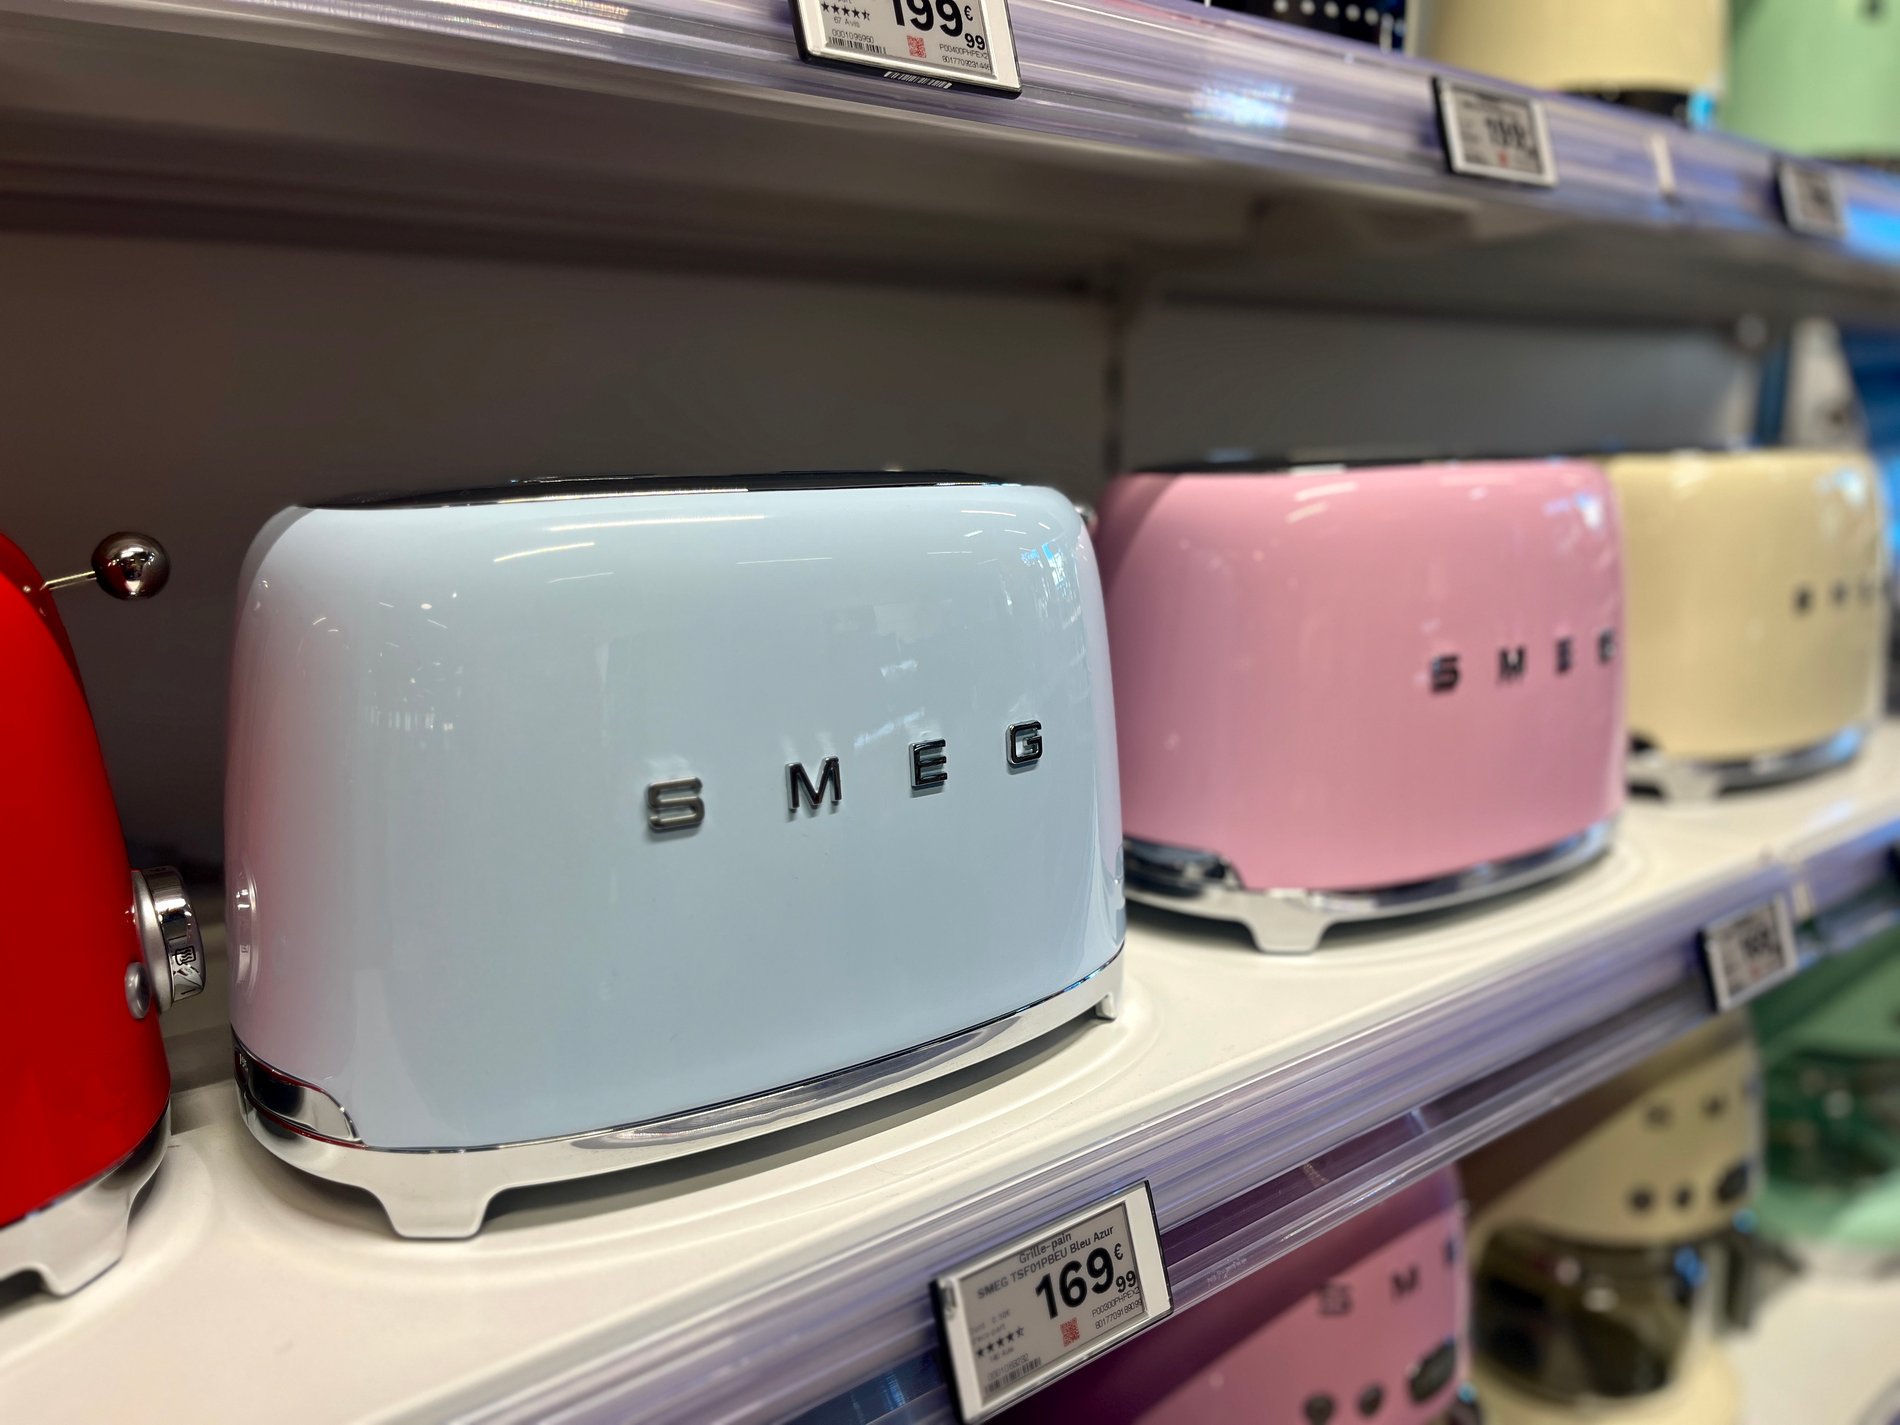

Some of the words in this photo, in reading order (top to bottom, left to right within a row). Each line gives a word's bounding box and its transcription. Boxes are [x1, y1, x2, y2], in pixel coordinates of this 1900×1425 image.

[893, 0, 963, 37] 199
[964, 5, 974, 21] €
[965, 33, 985, 50] 99
[645, 719, 1044, 831] SMEG
[976, 1275, 1009, 1300] SMEG
[1009, 1248, 1068, 1284] TSF01PBEU
[1069, 1236, 1091, 1254] Bleu
[1093, 1225, 1115, 1243] Azur
[1018, 1231, 1072, 1264] Grille-pain
[1114, 1243, 1124, 1261] €
[1035, 1246, 1115, 1320] 169
[1115, 1270, 1136, 1293] 99
